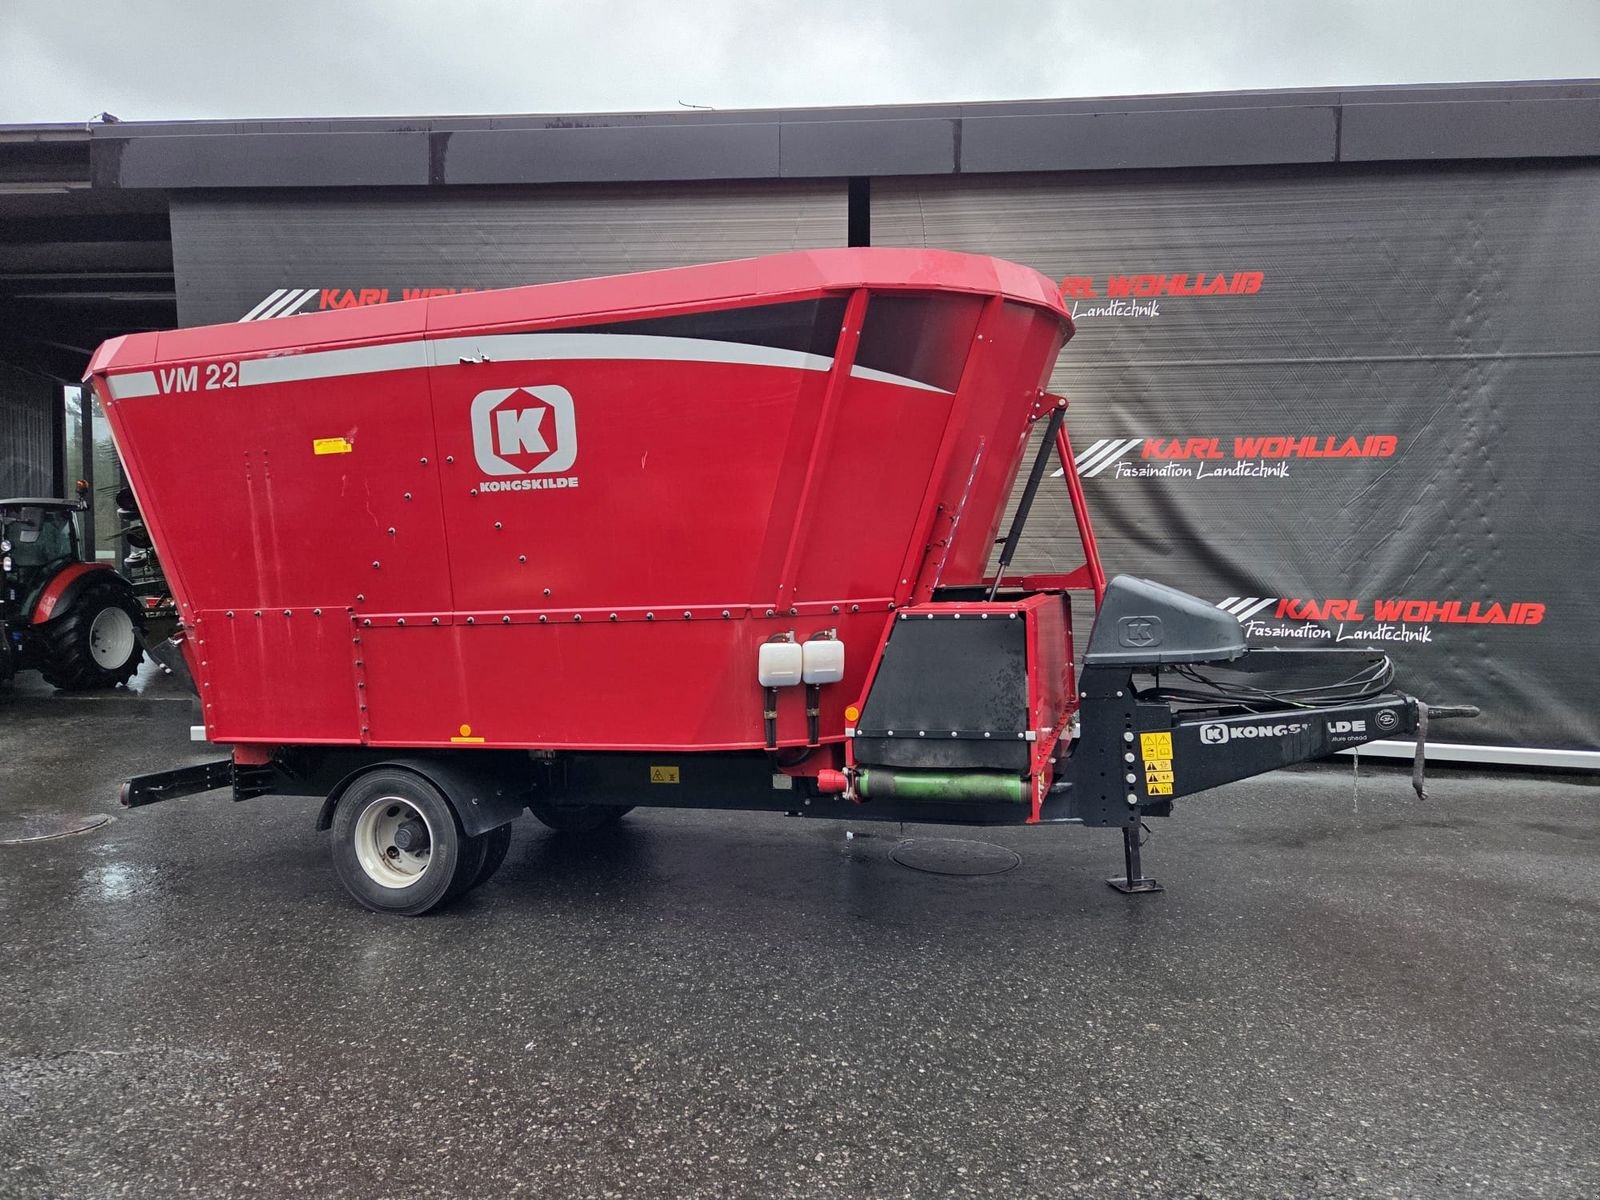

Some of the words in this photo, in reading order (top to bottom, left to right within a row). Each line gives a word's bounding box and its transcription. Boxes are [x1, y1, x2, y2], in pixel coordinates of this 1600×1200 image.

[1071, 299, 1160, 320] Landtechnik
[160, 366, 198, 394] VM
[205, 362, 237, 391] 22
[496, 406, 550, 455] K
[1141, 438, 1224, 460] KARL
[1114, 460, 1192, 479] Faszination
[1196, 460, 1290, 479] Landtechnik
[479, 477, 579, 493] KONGSKILDE
[1274, 598, 1365, 621] KARL
[1245, 620, 1331, 639] Faszination
[1336, 623, 1432, 643] Landtechnik
